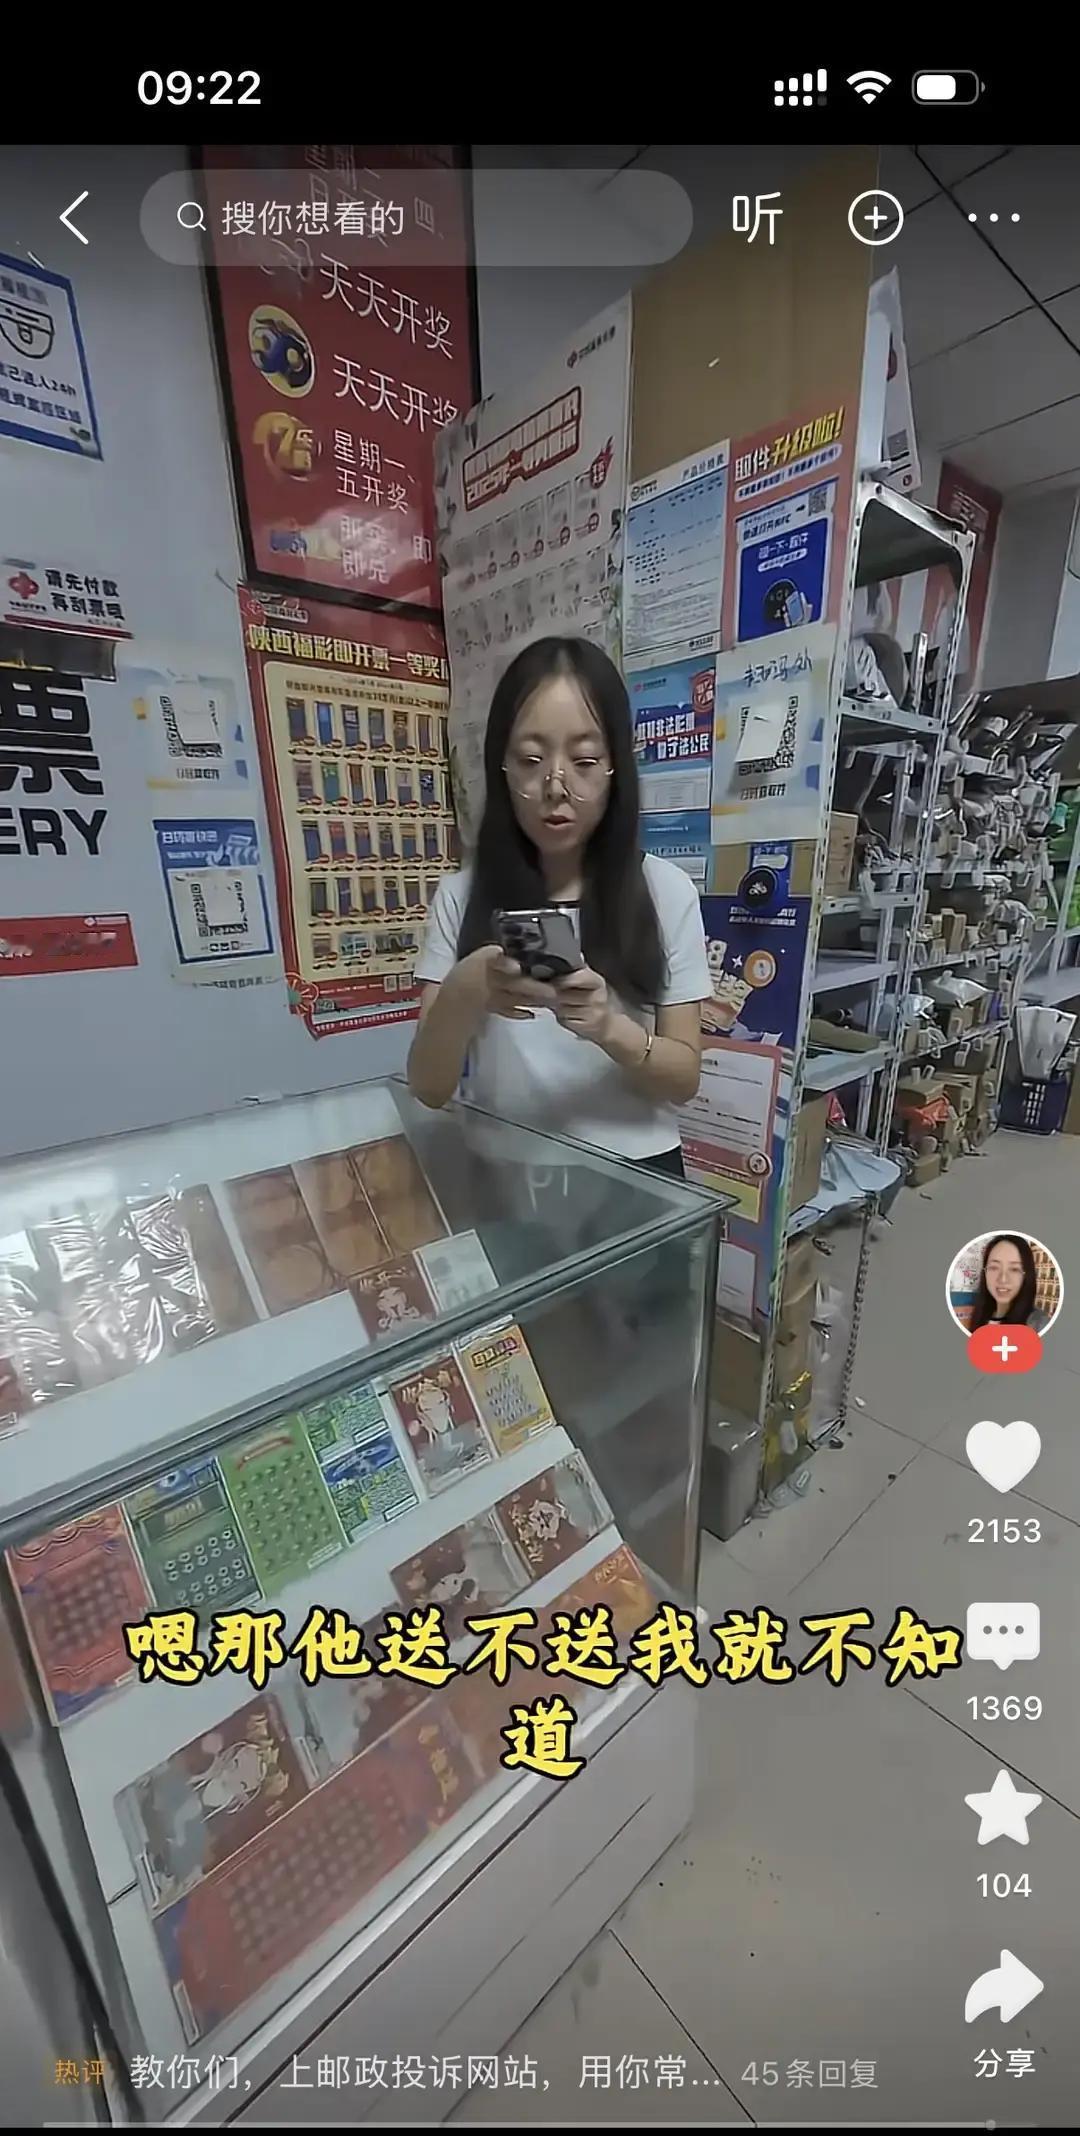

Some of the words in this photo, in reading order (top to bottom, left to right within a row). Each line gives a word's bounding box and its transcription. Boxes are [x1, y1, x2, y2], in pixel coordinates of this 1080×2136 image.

[319, 252, 453, 360] 天天开奖
[335, 465, 409, 515] 五开奖
[45, 568, 120, 598] 请先付款
[247, 623, 449, 681] 陕西福彩即开票一等奖
